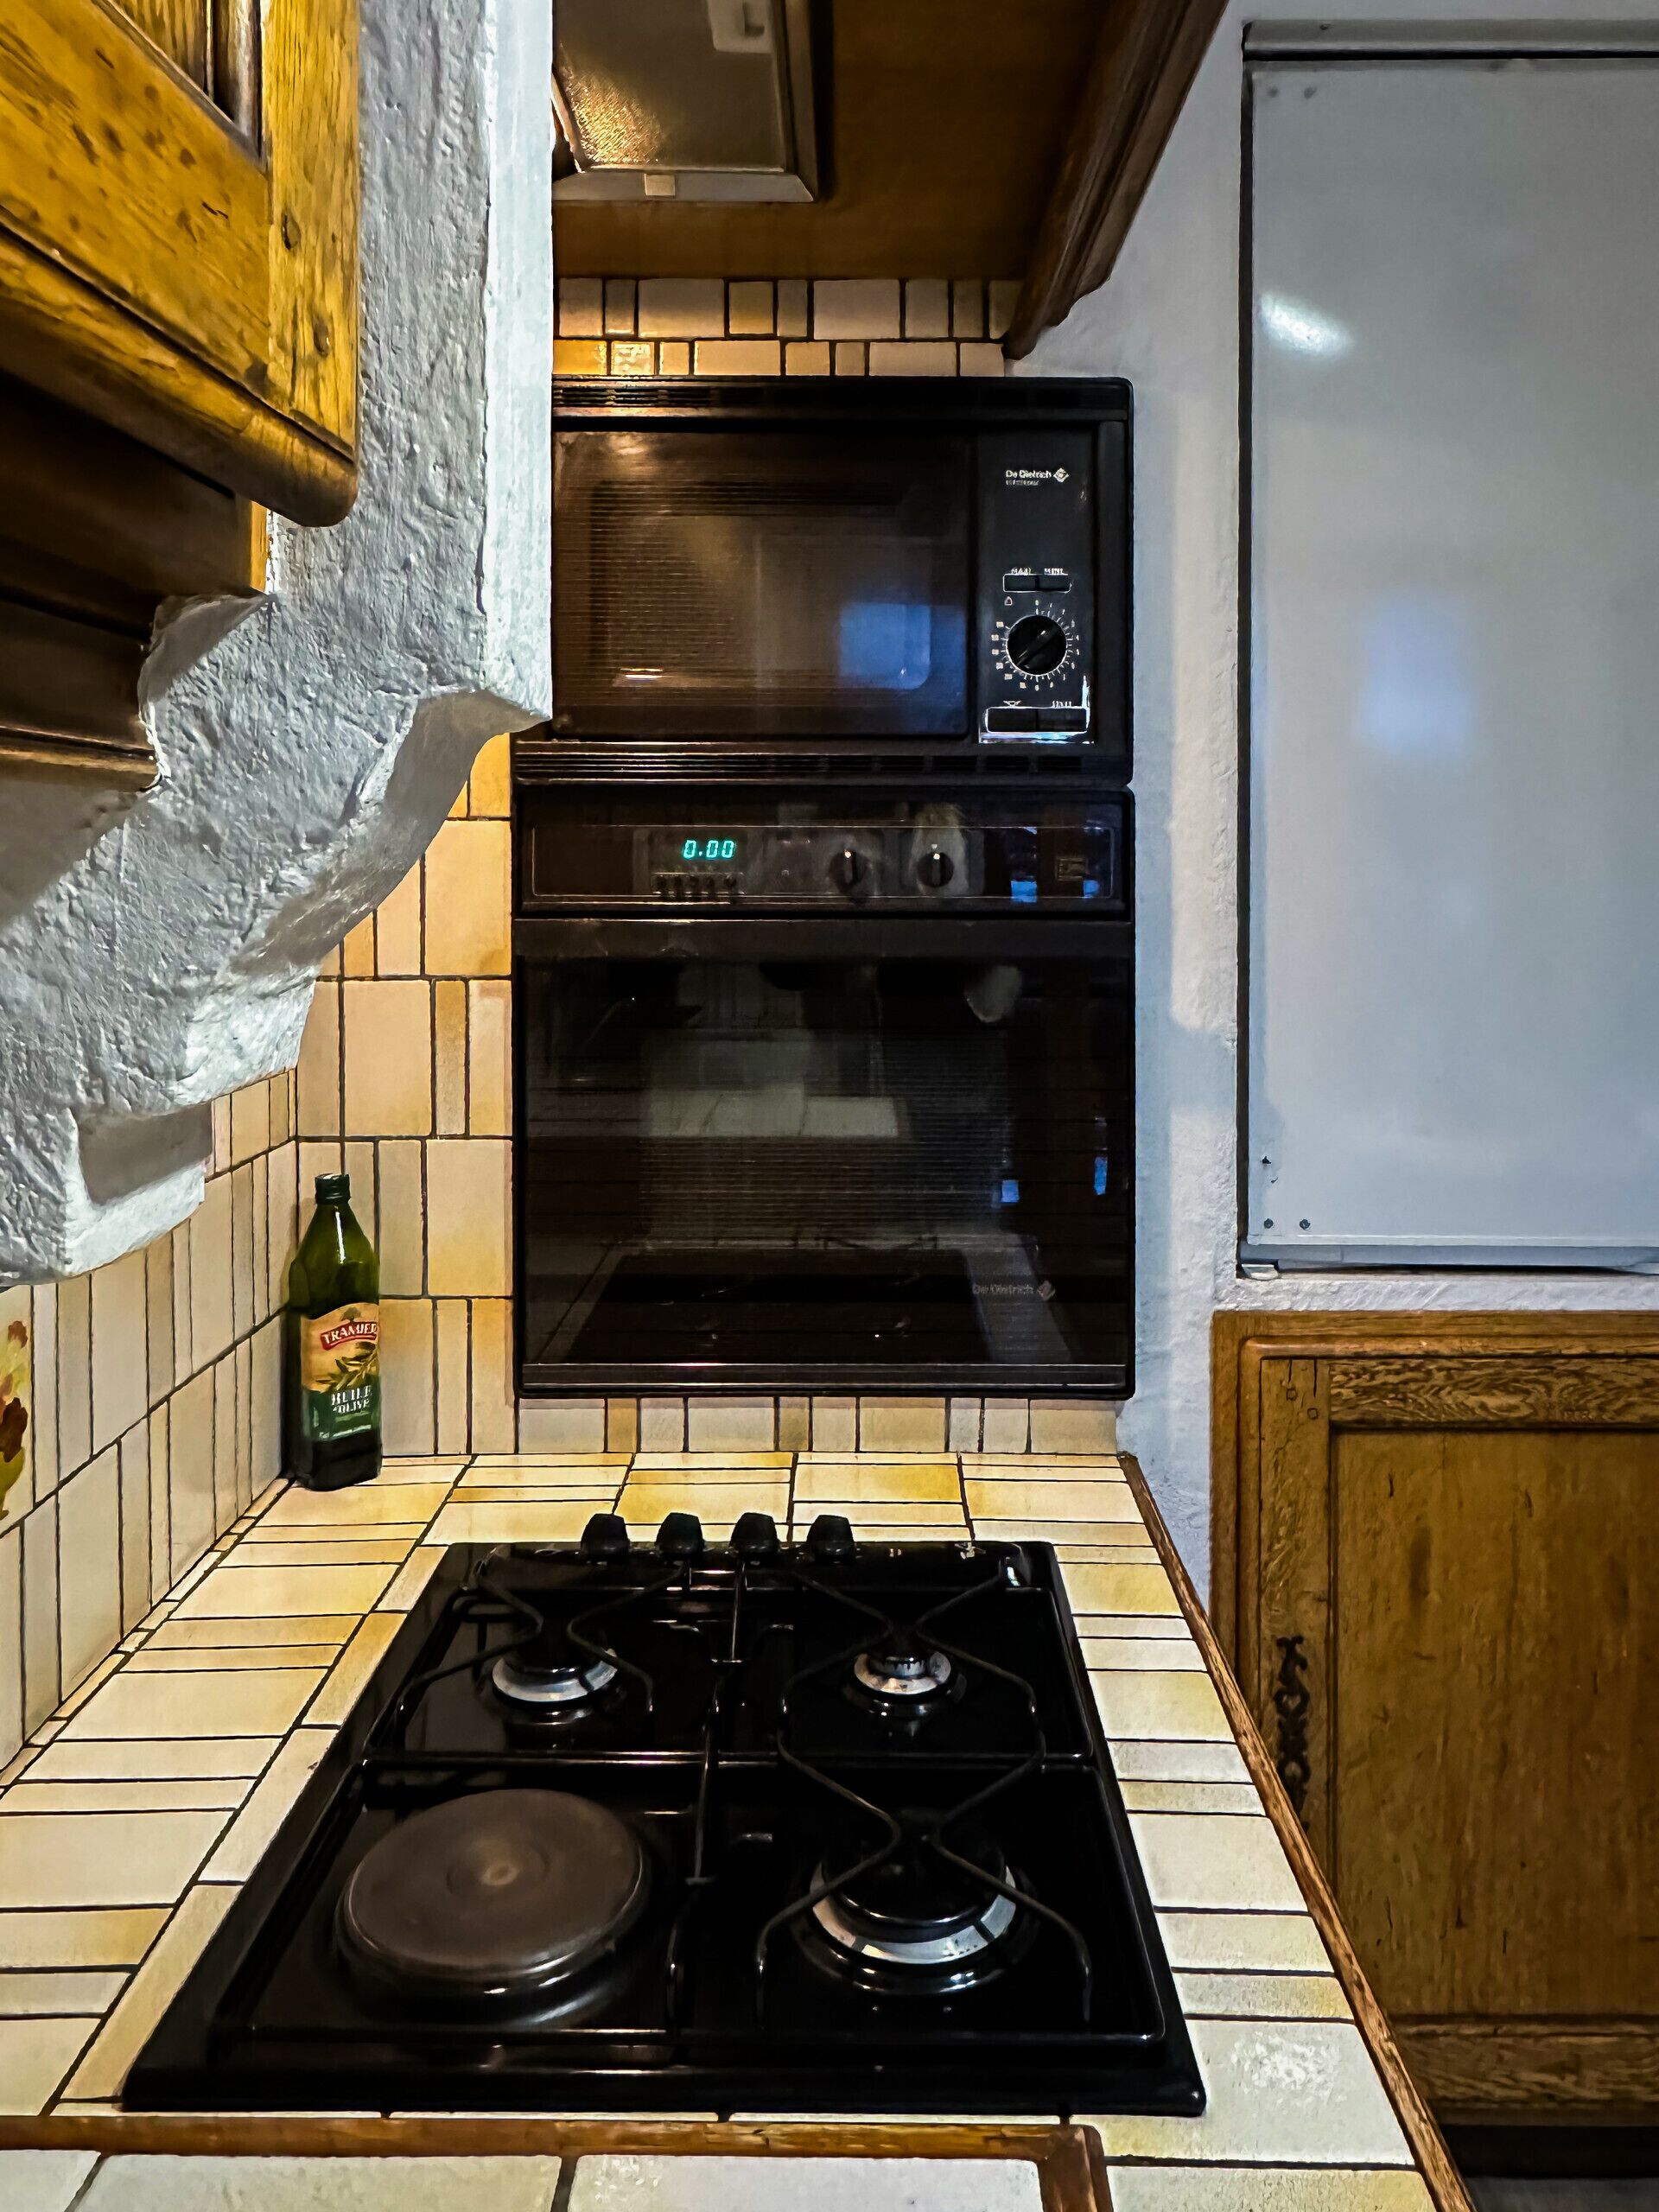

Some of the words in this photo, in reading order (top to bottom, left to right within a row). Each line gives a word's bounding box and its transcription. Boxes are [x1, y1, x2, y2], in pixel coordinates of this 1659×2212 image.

[1005, 469, 1018, 478] De
[1019, 469, 1052, 479] Dietrich
[682, 839, 735, 859] 0.00
